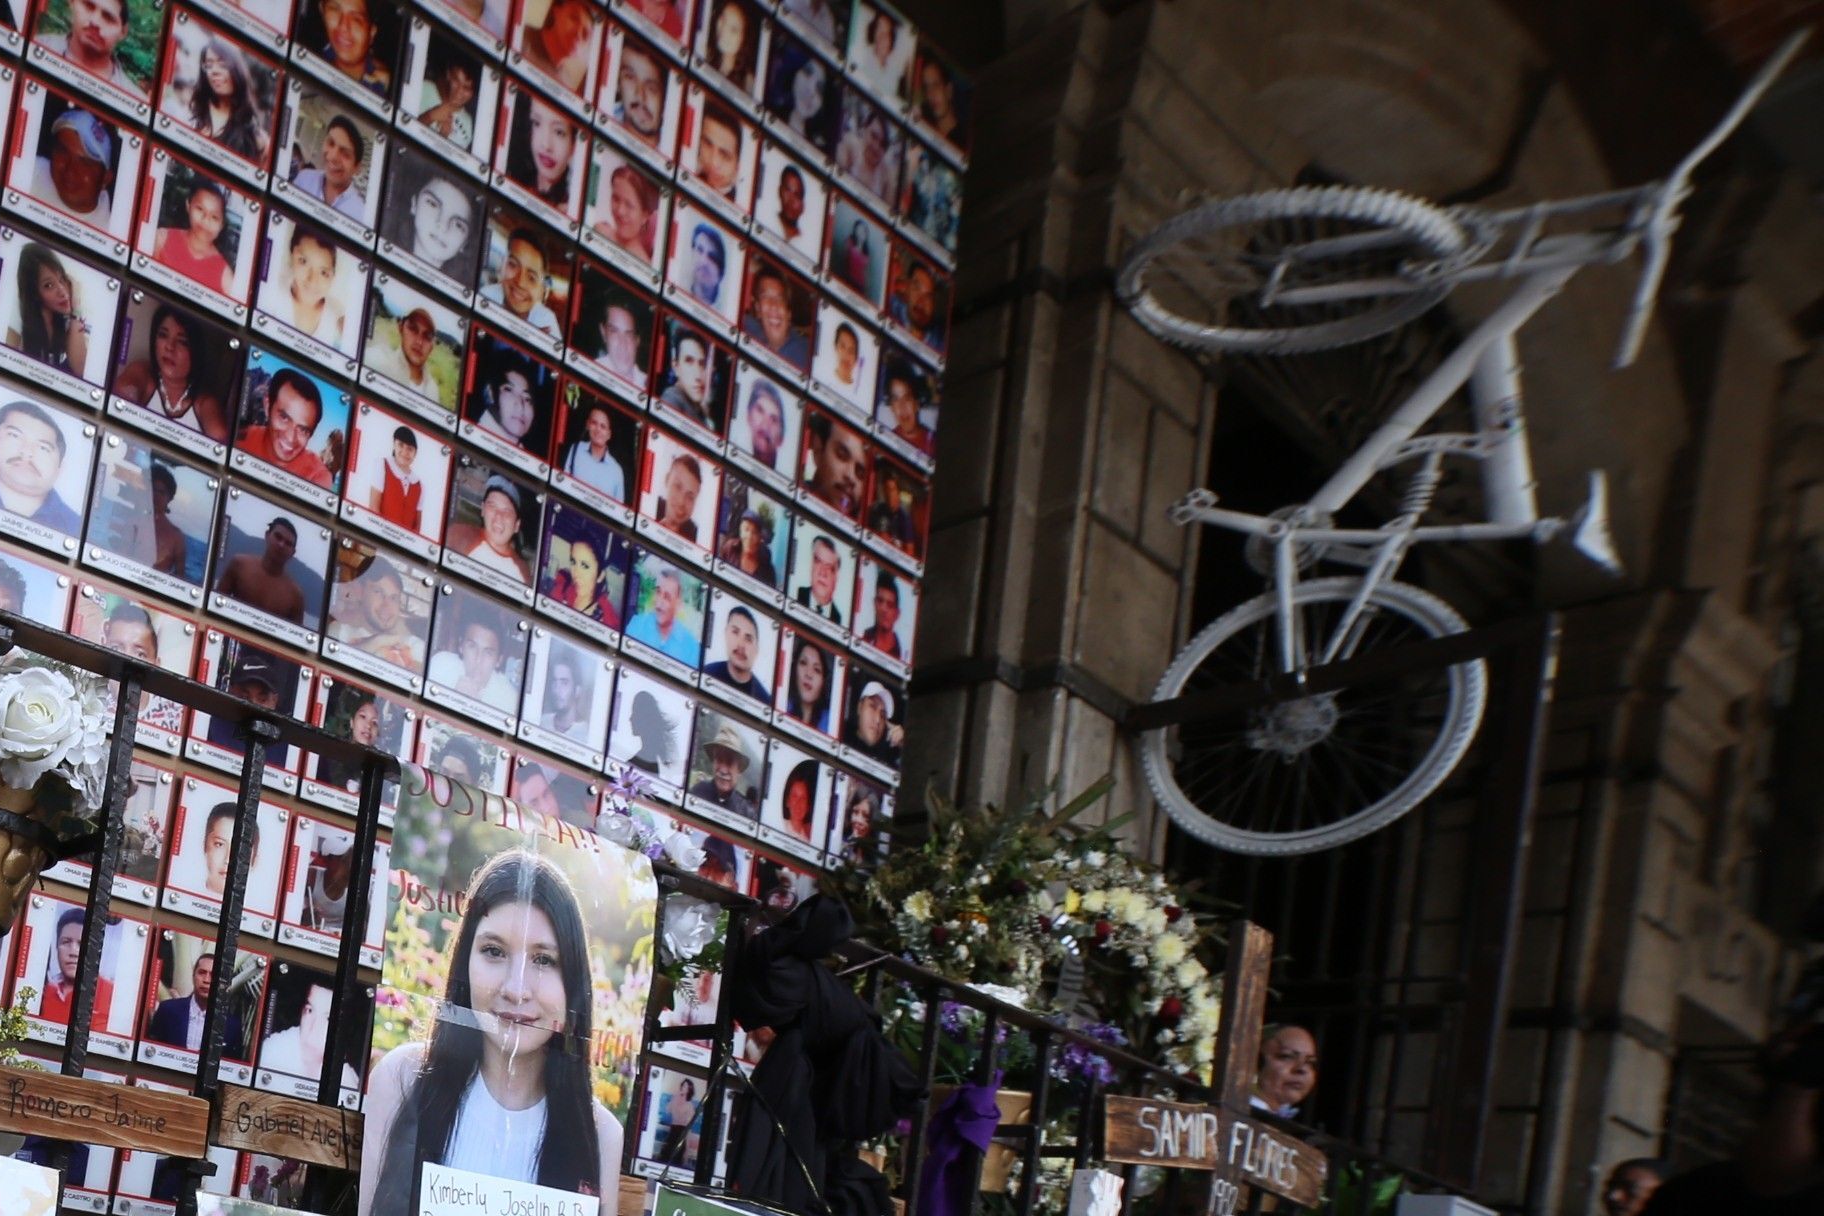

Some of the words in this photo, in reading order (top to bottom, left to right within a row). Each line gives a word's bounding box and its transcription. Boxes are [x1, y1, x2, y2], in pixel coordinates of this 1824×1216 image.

[7, 1077, 93, 1121] Romero
[103, 1092, 168, 1134] Jaime
[236, 1102, 307, 1140] Gabriel
[1138, 1106, 1219, 1162] SAMIR
[1228, 1120, 1299, 1191] FLORES
[428, 1172, 489, 1215] Kimberly
